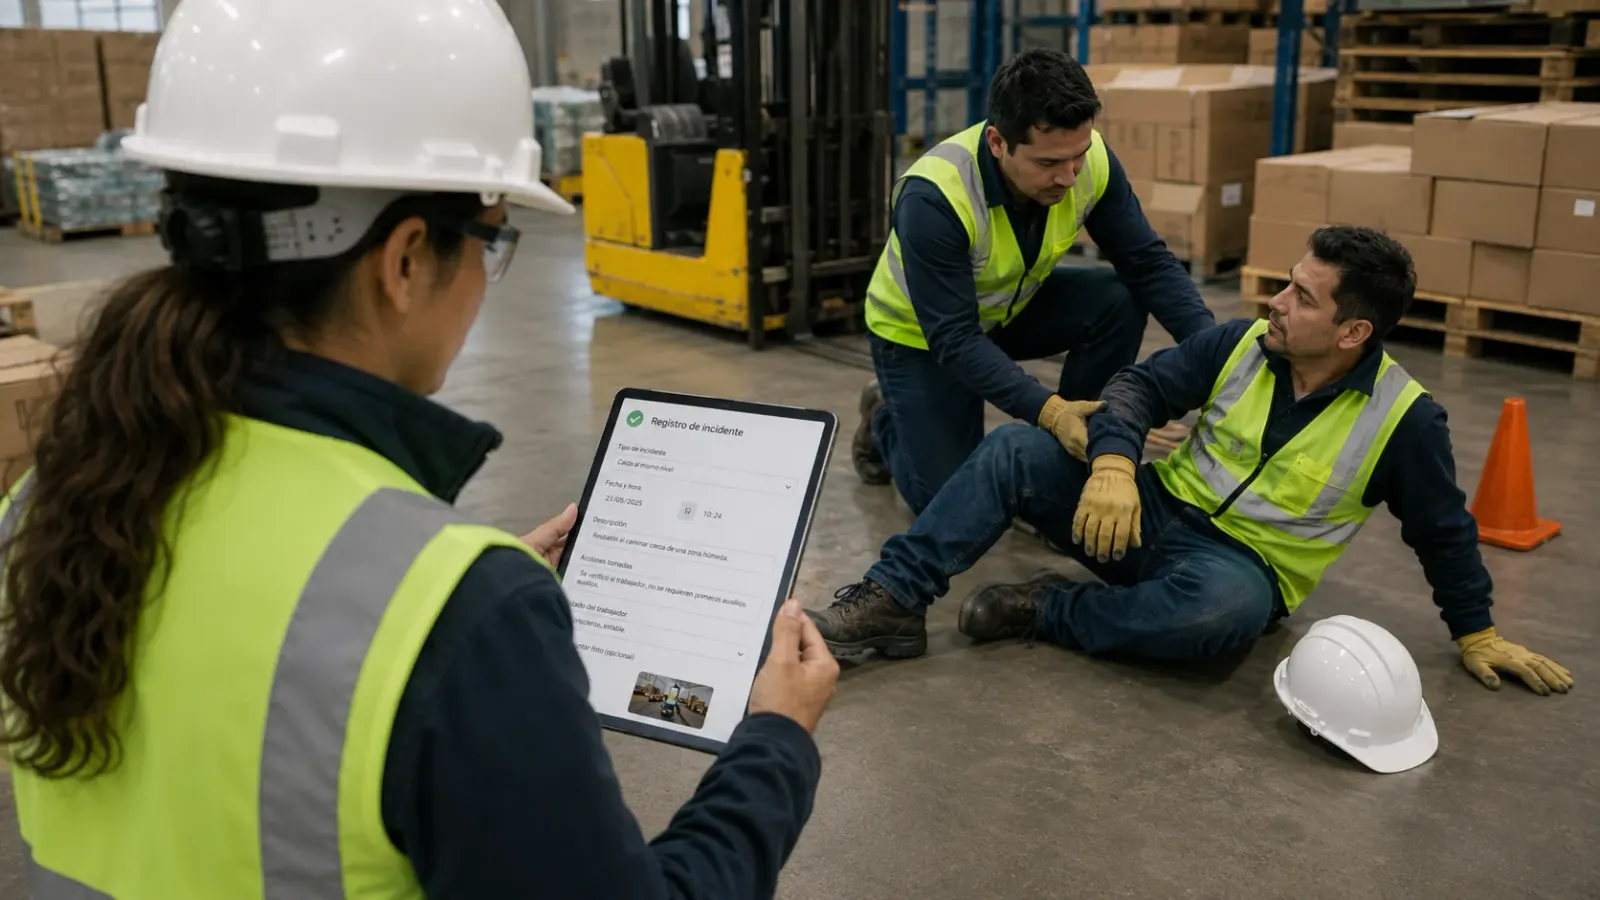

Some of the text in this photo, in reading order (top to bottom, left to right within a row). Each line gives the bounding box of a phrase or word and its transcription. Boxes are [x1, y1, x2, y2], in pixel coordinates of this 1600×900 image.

[651, 416, 744, 437] Registro de incidente
[618, 443, 630, 452] Tipo
[640, 446, 667, 456] incidente
[660, 464, 674, 473] nivel
[605, 479, 622, 488] Fecha
[627, 483, 642, 491] hora
[605, 494, 643, 507] 21/05/2025
[703, 510, 723, 519] 10:24
[593, 516, 627, 528] Descripción
[625, 538, 649, 548] caminar
[649, 542, 666, 551] cerca
[666, 544, 675, 552] de
[675, 547, 687, 555] una
[687, 549, 702, 557] zona
[580, 554, 633, 569] Acciones tomadas
[580, 569, 587, 577] Se
[664, 586, 694, 597] requieren
[694, 592, 722, 603] primeros
[586, 603, 596, 611] del
[596, 606, 628, 617] trabajador
[591, 645, 604, 654] foto
[605, 648, 635, 661] (opcional)
